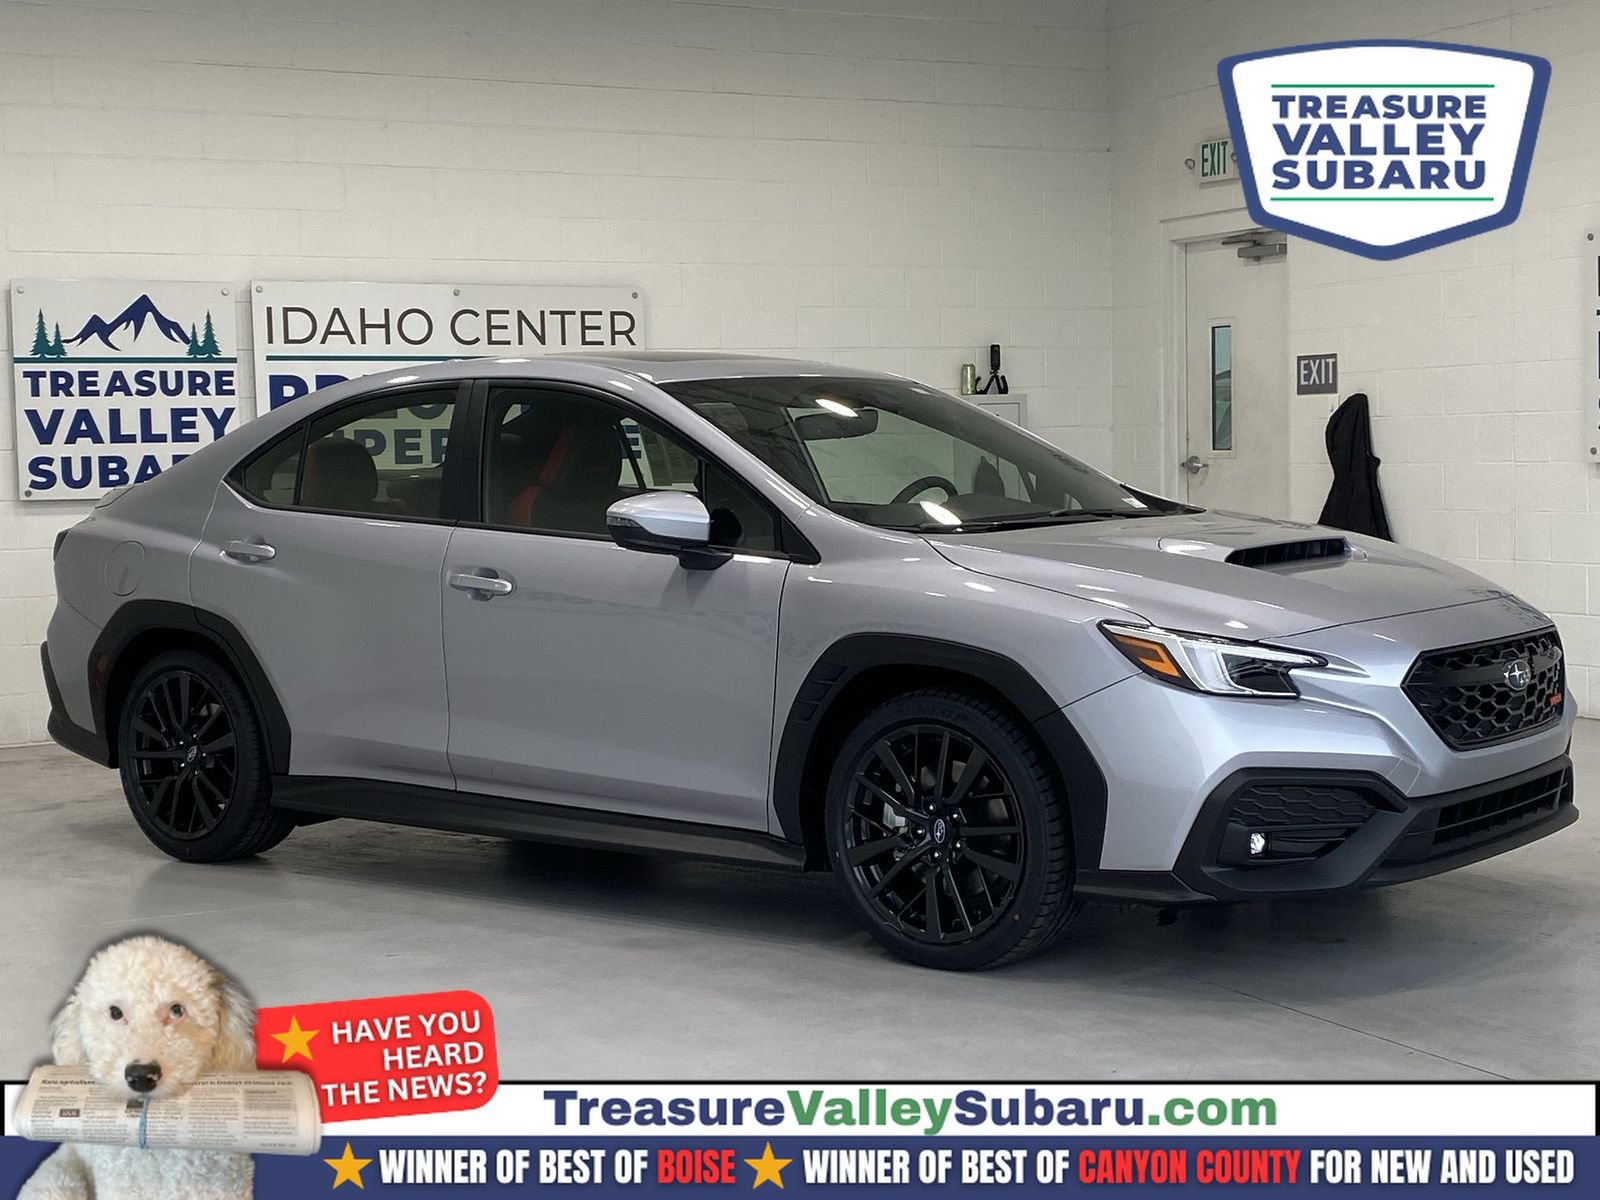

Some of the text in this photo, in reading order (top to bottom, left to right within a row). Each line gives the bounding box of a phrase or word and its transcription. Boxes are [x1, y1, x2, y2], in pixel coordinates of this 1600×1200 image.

[1201, 140, 1228, 178] EXIT
[265, 305, 637, 347] IDAHO CENTER
[22, 369, 236, 398] TREASURE
[1300, 358, 1336, 385] EXIT
[24, 407, 236, 445] VALLEY
[27, 454, 192, 490] SUBA
